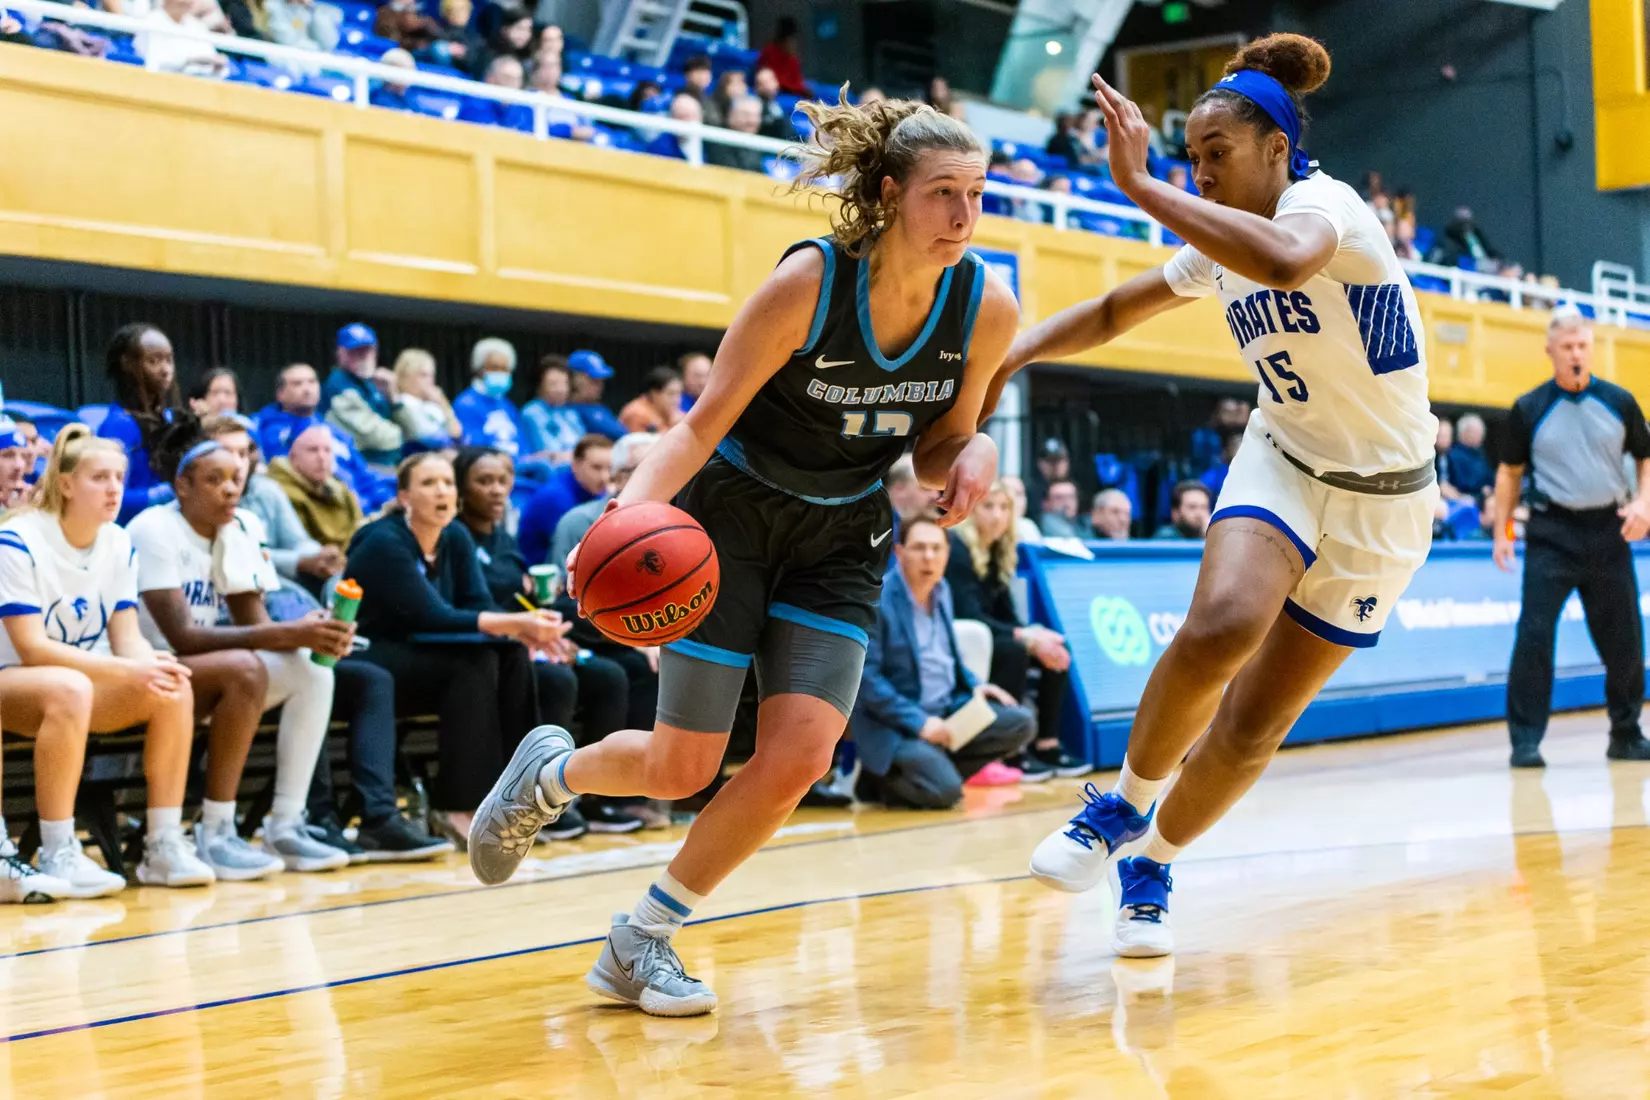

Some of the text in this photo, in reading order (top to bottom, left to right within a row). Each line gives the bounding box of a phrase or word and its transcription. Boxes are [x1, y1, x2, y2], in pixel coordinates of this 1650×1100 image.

[1226, 289, 1321, 349] IRATES
[939, 350, 955, 362] Ivy
[1255, 350, 1309, 404] 15
[806, 378, 955, 404] COLUMBIA
[620, 580, 713, 634] Wilson
